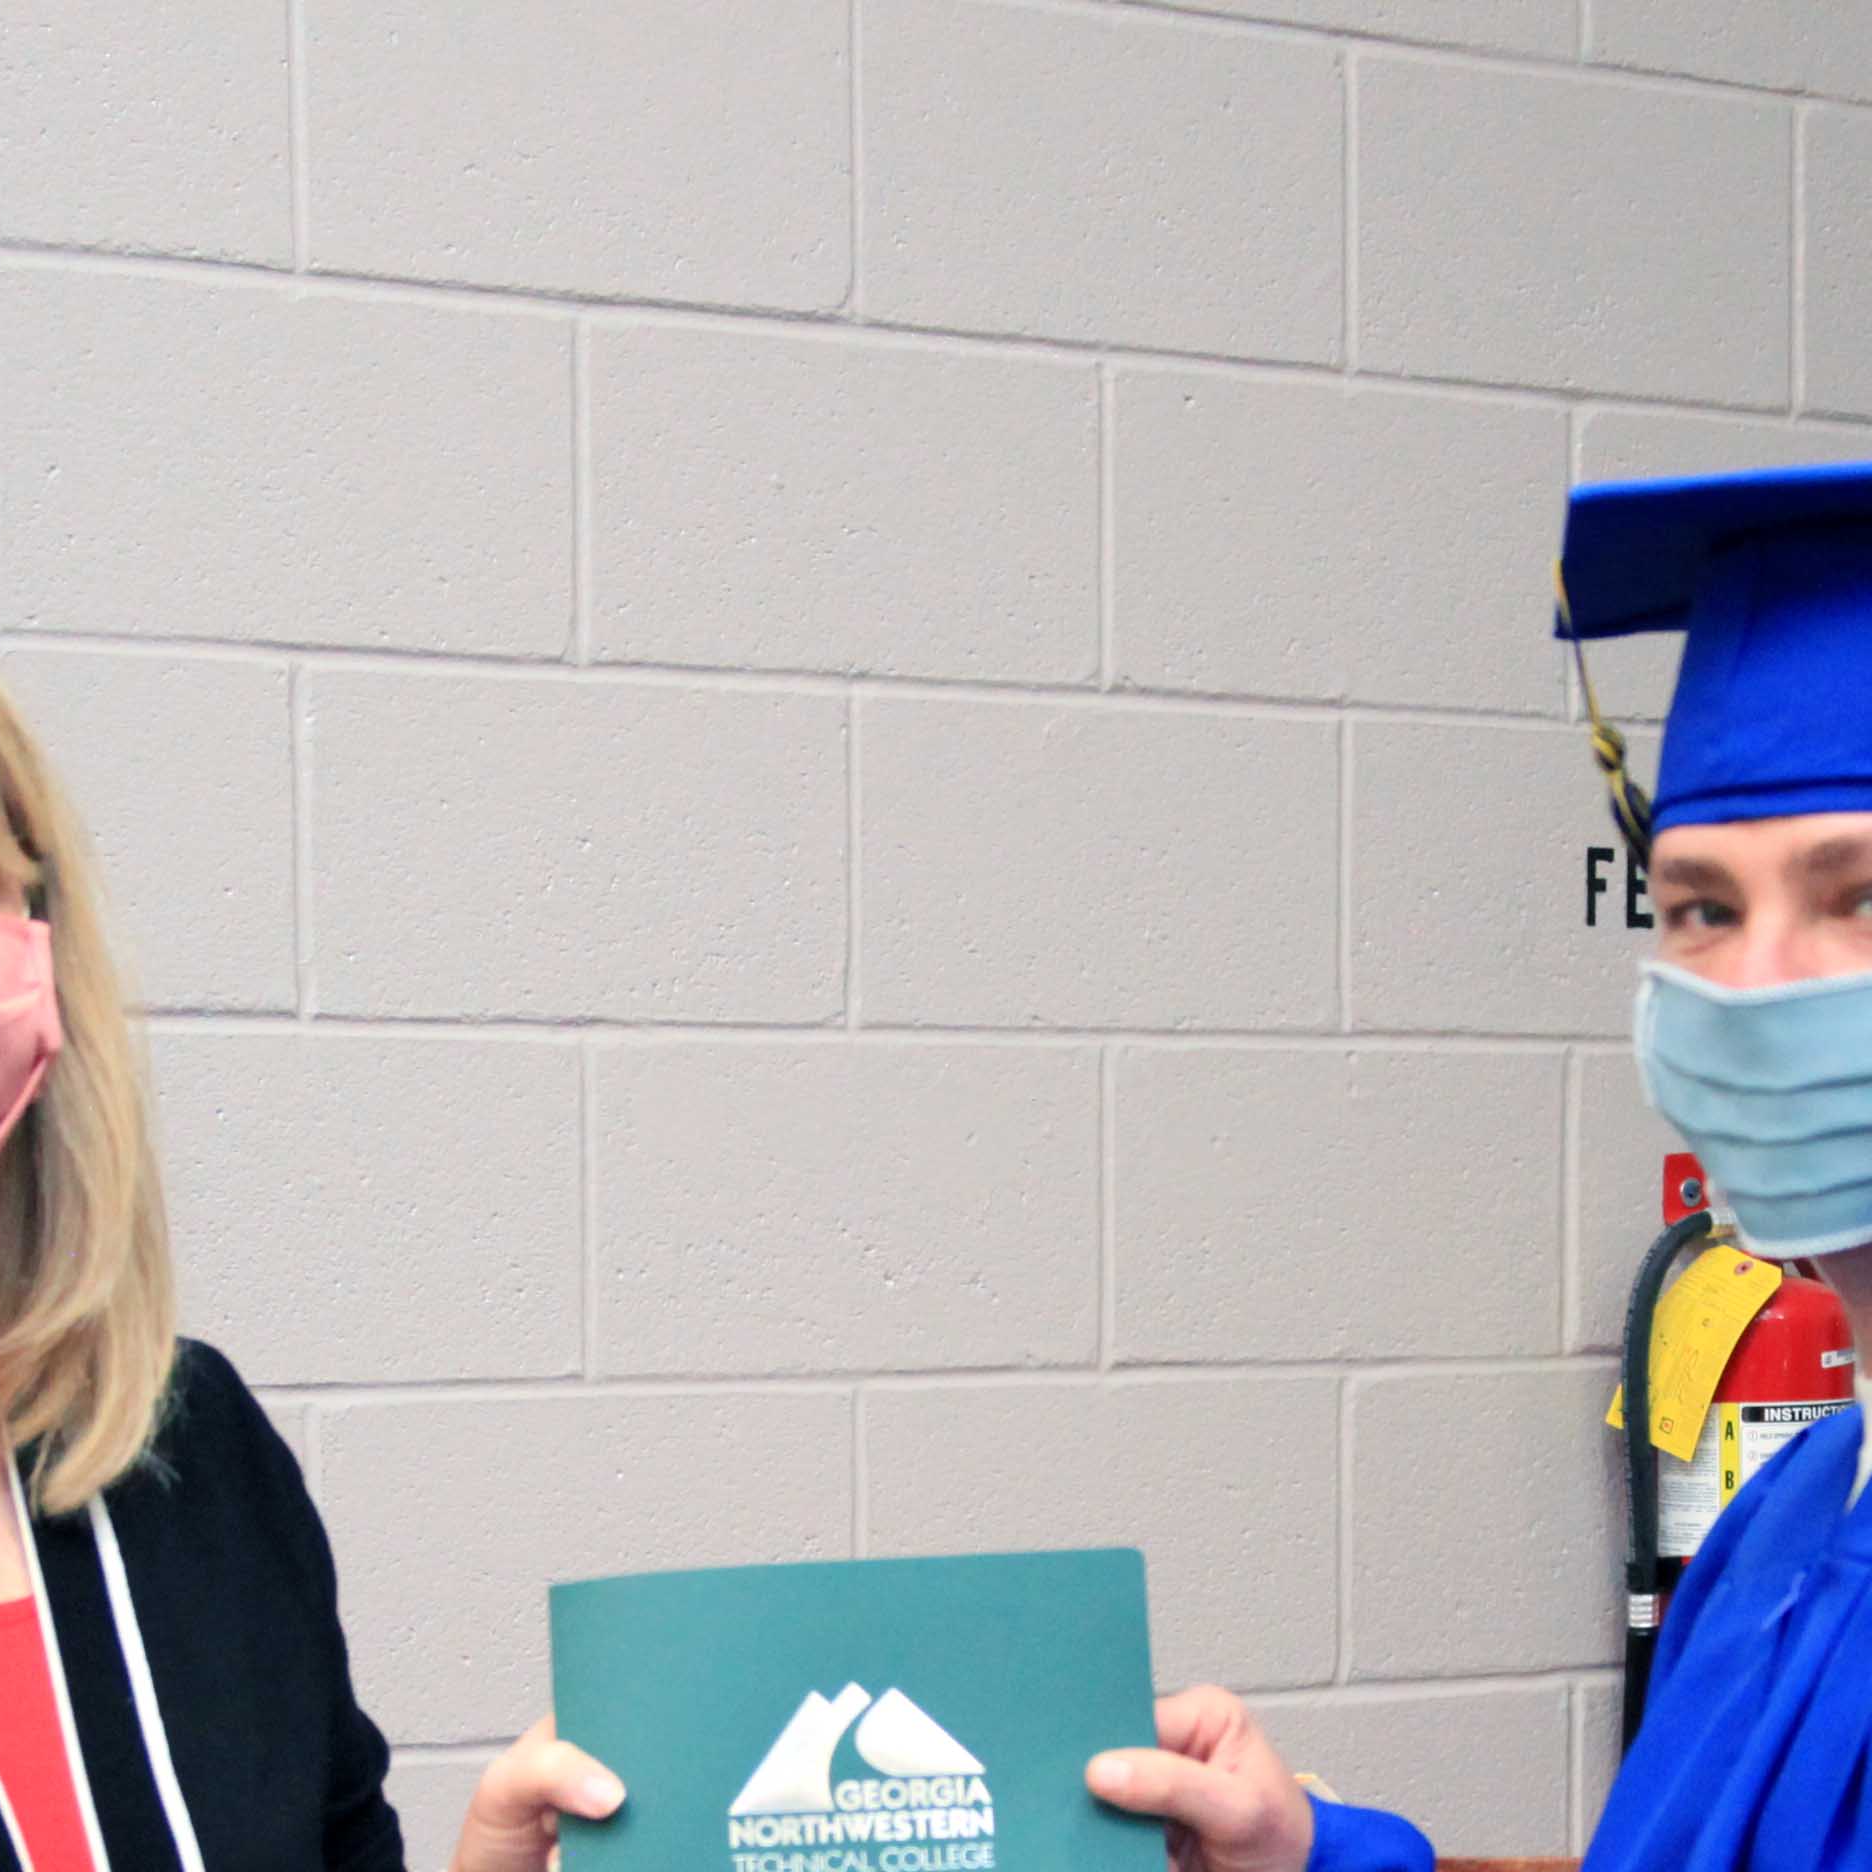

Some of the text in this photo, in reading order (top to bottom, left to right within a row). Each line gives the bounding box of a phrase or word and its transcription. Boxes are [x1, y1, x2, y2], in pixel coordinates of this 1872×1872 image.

[1764, 1405, 1844, 1422] INSTRUCT
[1725, 1421, 1735, 1441] A
[1725, 1470, 1735, 1490] B
[834, 1776, 993, 1813] GEORGIA
[729, 1806, 996, 1849] NORTHWESTERN
